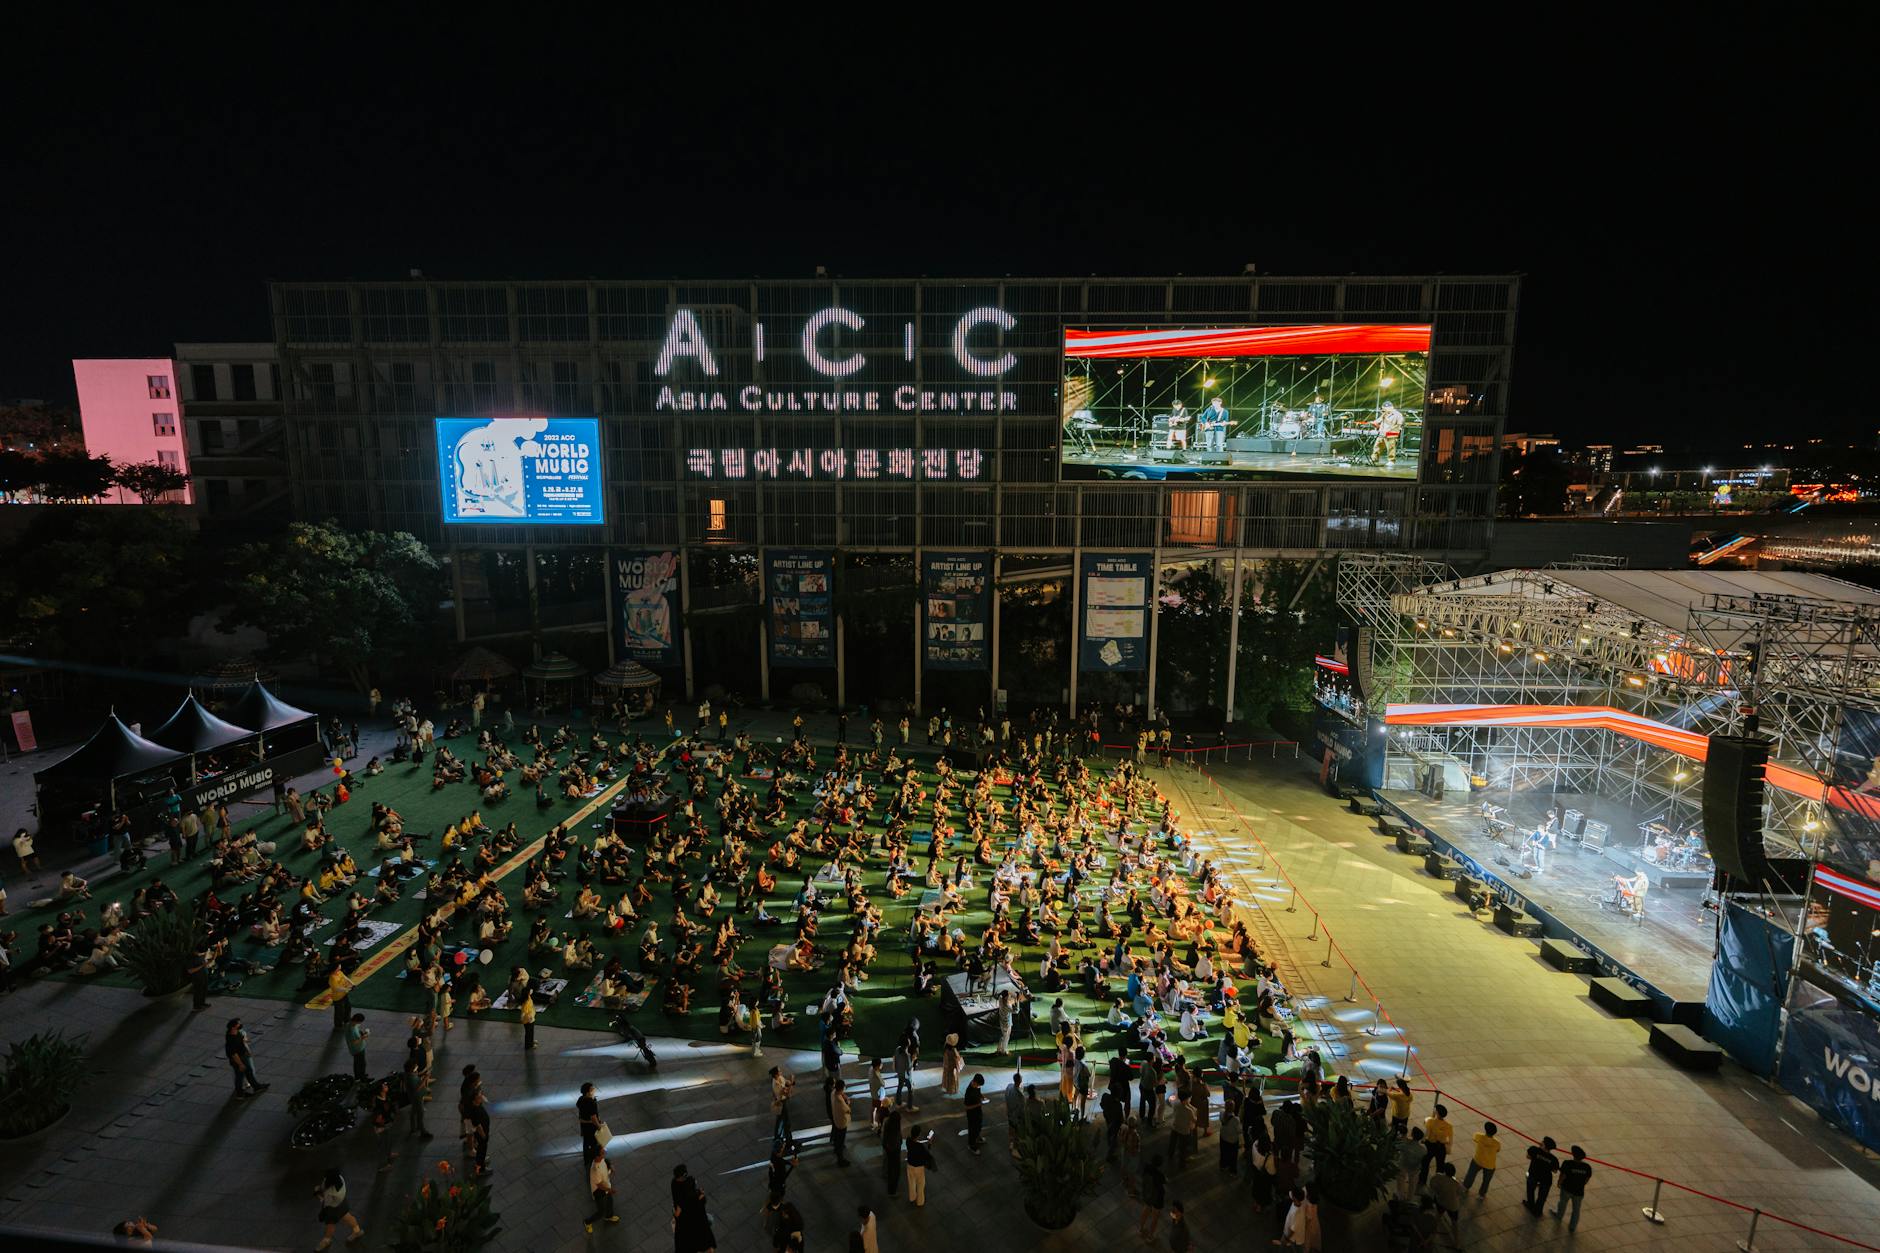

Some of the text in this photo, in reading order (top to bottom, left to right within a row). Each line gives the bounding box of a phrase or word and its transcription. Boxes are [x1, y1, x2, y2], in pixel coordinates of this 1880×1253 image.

[536, 444, 589, 458] WORLD
[536, 459, 588, 473] MUSIC
[687, 448, 982, 478] 국립아시아문화전당
[618, 560, 669, 574] WORLD
[774, 560, 824, 568] ARTIST LINE UP
[931, 562, 982, 570] ARTIST LINE UP
[1097, 563, 1137, 571] TIME TABLE
[196, 768, 272, 805] WORLD MUSIC
